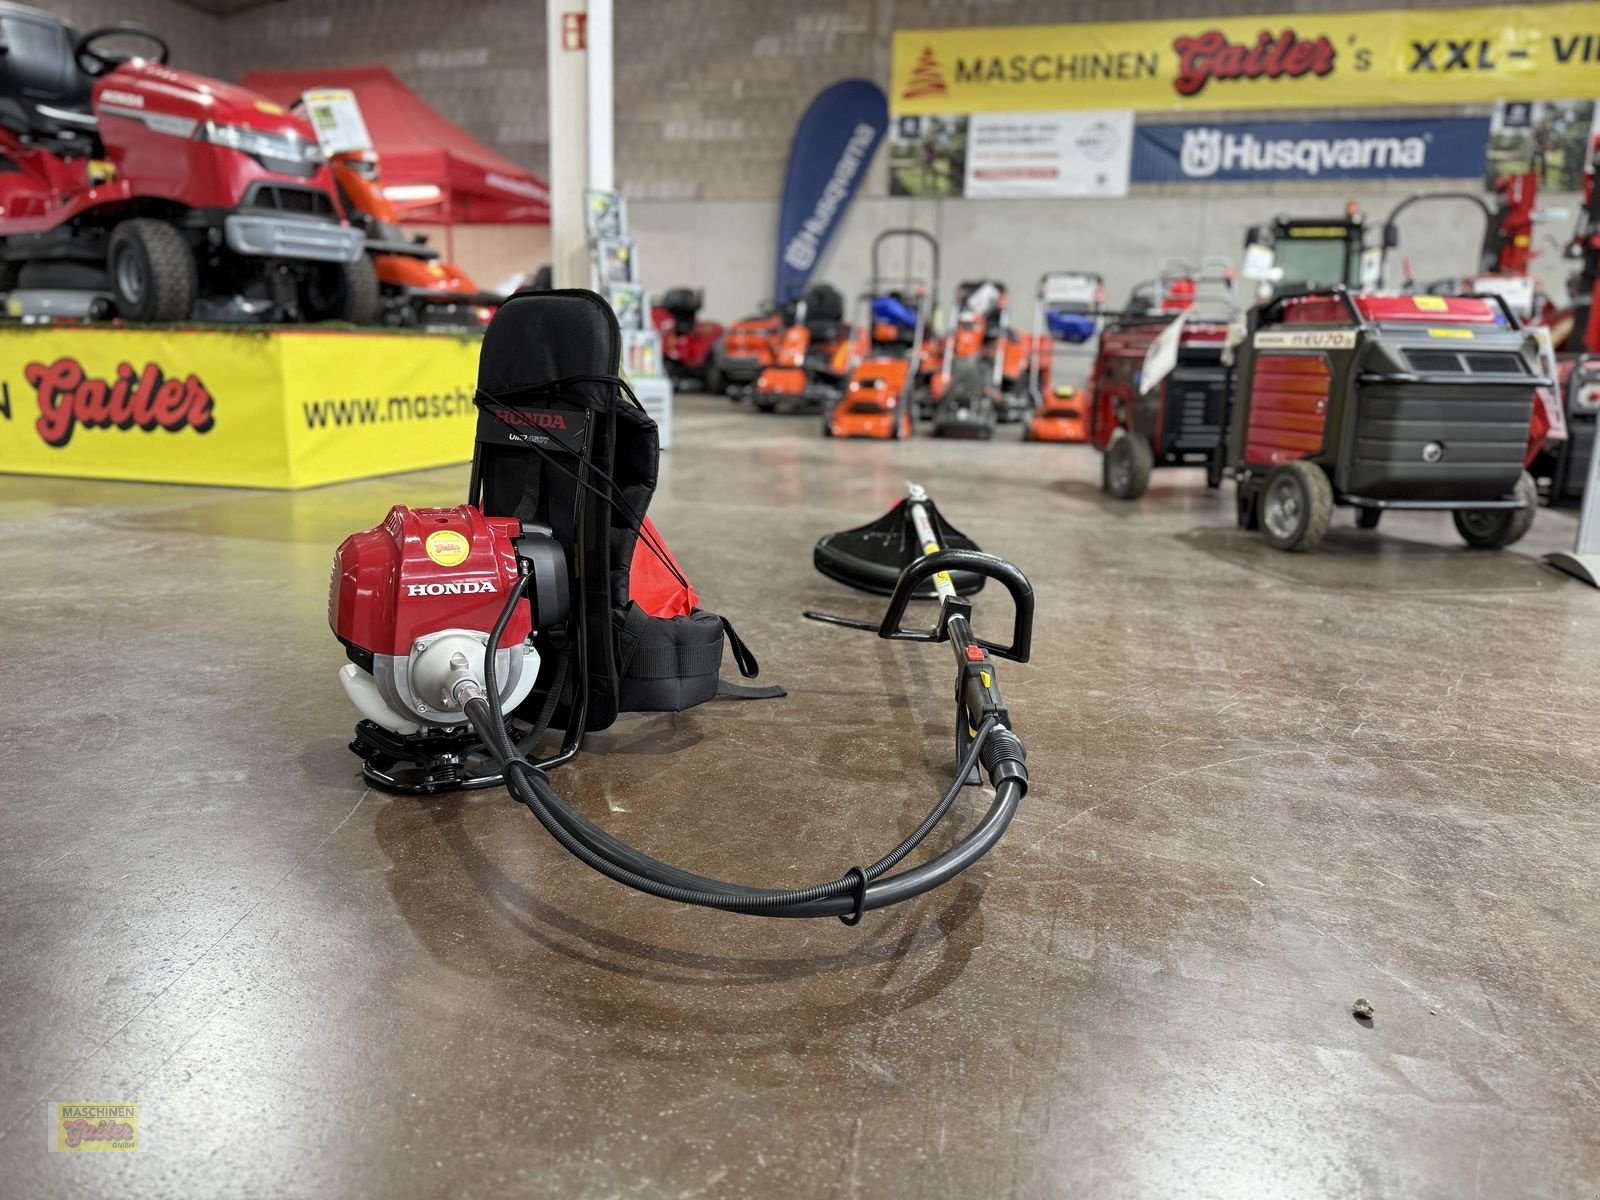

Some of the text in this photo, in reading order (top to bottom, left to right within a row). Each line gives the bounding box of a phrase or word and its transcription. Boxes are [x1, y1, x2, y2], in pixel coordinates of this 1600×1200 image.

[955, 53, 1159, 82] MASCHINEN
[1172, 29, 1337, 95] Gailer
[1222, 132, 1427, 176] Husqvarna
[796, 121, 876, 247] Husqvarna
[24, 357, 215, 448] Gailer
[495, 409, 567, 430] HONDA
[407, 581, 498, 597] HONDA
